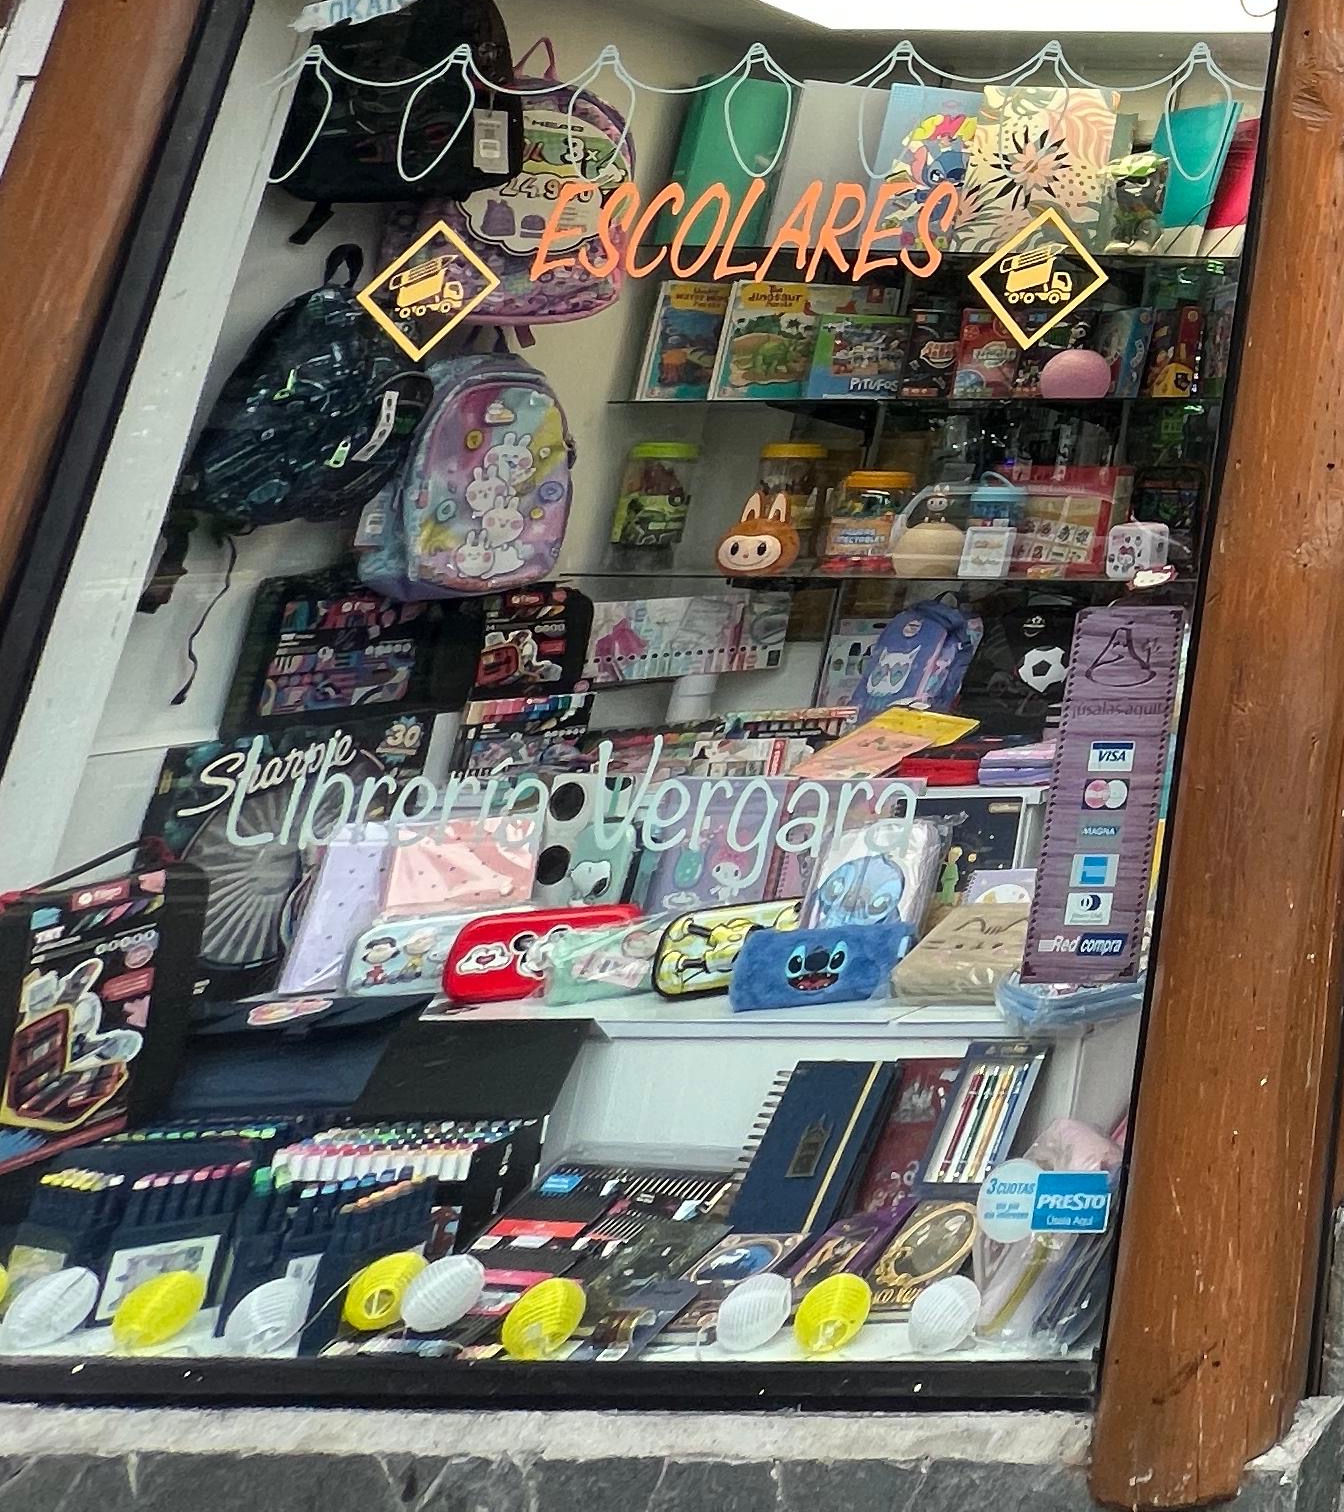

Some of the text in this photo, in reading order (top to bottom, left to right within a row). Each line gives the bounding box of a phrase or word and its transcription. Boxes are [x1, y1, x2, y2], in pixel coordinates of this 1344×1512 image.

[530, 179, 957, 282] ESCOLARES
[386, 723, 420, 747] 30
[1098, 750, 1126, 762] VISA
[598, 734, 918, 874] Vergara
[1080, 937, 1123, 956] compra
[986, 1177, 1036, 1195] 3 CUOTAS
[1036, 1193, 1106, 1211] PRESTO
